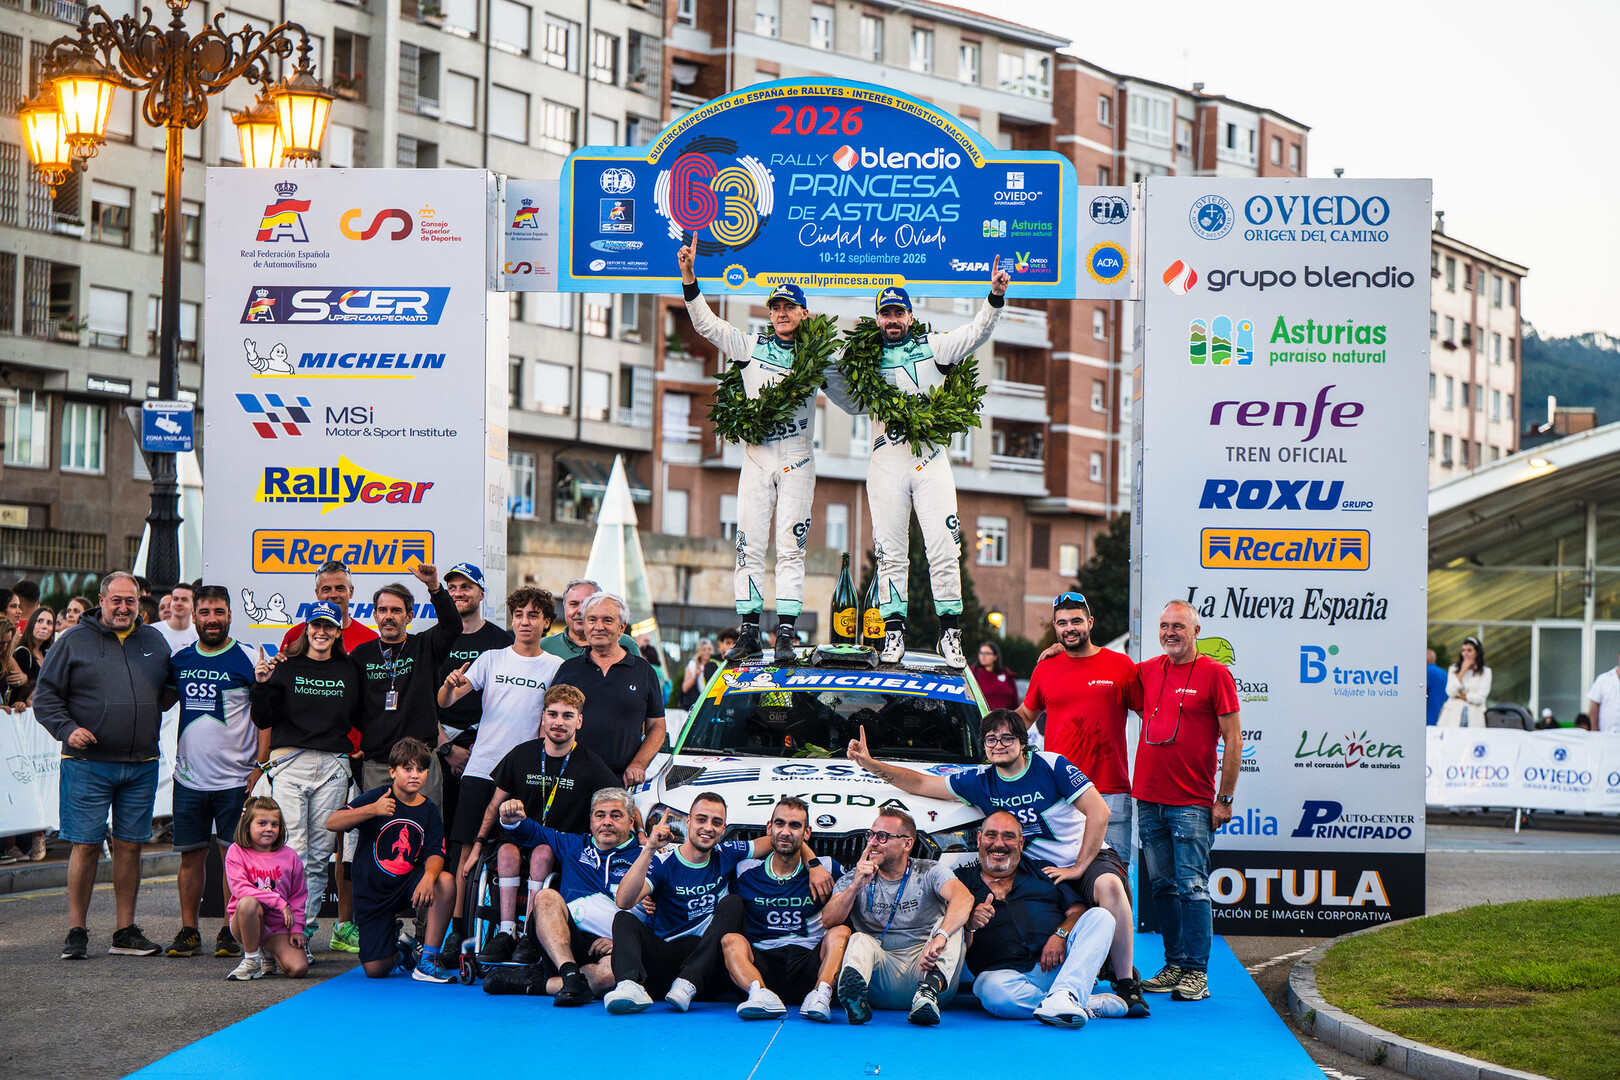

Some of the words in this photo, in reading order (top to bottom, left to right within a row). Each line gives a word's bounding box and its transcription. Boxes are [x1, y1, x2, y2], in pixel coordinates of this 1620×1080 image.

[650, 100, 731, 160] SUPERCAMPEONATO
[734, 97, 745, 106] de
[746, 88, 784, 103] ESPAÑA
[787, 87, 798, 96] de
[801, 87, 844, 96] RALLYES
[852, 89, 893, 105] INTERÉS
[895, 99, 943, 127] TURÍSTICO
[943, 126, 981, 163] NACIONAL
[770, 105, 864, 136] 2026
[770, 153, 829, 166] RALLY
[861, 147, 961, 169] blendio
[788, 174, 960, 198] PRINCESA
[669, 152, 758, 246] 63
[788, 206, 817, 220] DE
[820, 203, 960, 222] ASTURIAS
[1244, 195, 1390, 226] OVIEDO
[420, 221, 449, 229] Consejo
[420, 228, 451, 237] Superior
[1010, 219, 1053, 230] Asturias
[431, 235, 462, 243] Deportes
[798, 222, 862, 249] Ciudad
[869, 228, 887, 248] de
[894, 224, 947, 250] Oviedo
[1244, 229, 1297, 242] ORIGEN
[1301, 230, 1327, 243] DEL
[1330, 230, 1389, 243] CAMINO
[240, 250, 256, 258] Real
[257, 249, 296, 259] Federación
[298, 250, 330, 260] Española
[819, 252, 846, 264] 10-12
[848, 253, 901, 266] septiembre
[903, 253, 927, 264] 2026
[1096, 258, 1119, 267] ACPA
[253, 260, 262, 268] de
[263, 260, 317, 269] Automovilismo
[766, 275, 894, 287] www.rallyprincesa.com
[1207, 269, 1297, 292] grupo
[1304, 265, 1415, 288] blendio
[1269, 315, 1387, 345] Asturias
[298, 353, 447, 369] MICHELIN
[1269, 348, 1327, 366] paraíso
[1332, 350, 1386, 364] natural
[1209, 384, 1364, 443] renfe
[325, 427, 362, 437] Motor
[373, 427, 406, 438] Sport
[409, 427, 457, 437] Institute
[1225, 446, 1271, 462] TREN
[1277, 446, 1347, 463] OFICIAL
[264, 467, 435, 506] Rallycar
[1198, 478, 1345, 511] ROXU
[1342, 500, 1374, 509] GRUPO
[288, 538, 399, 566] Recalvi
[1234, 536, 1337, 562] Recalvi
[1187, 586, 1216, 618] La
[1220, 587, 1295, 619] Nueva
[1300, 587, 1389, 625] España
[1332, 665, 1399, 685] travel
[185, 682, 217, 698] GSS
[294, 686, 344, 697] Motorsport
[785, 674, 966, 695] MICHELIN
[1234, 678, 1269, 693] Baxa
[1367, 687, 1376, 697] la
[1378, 687, 1399, 697] vida
[1294, 730, 1405, 763] Llanera
[1314, 761, 1344, 769] corazón
[1359, 761, 1370, 769] de
[1446, 765, 1510, 780] OVIEDO
[1524, 766, 1592, 785] OVIEDO
[1338, 814, 1415, 824] AUTO-CENTER
[249, 865, 283, 880] MINNIE
[1208, 868, 1391, 907] OTULA
[766, 911, 802, 925] GSS
[1254, 909, 1269, 919] DE
[1272, 909, 1314, 920] IMAGEN
[1317, 910, 1392, 921] CORPORATIVA
